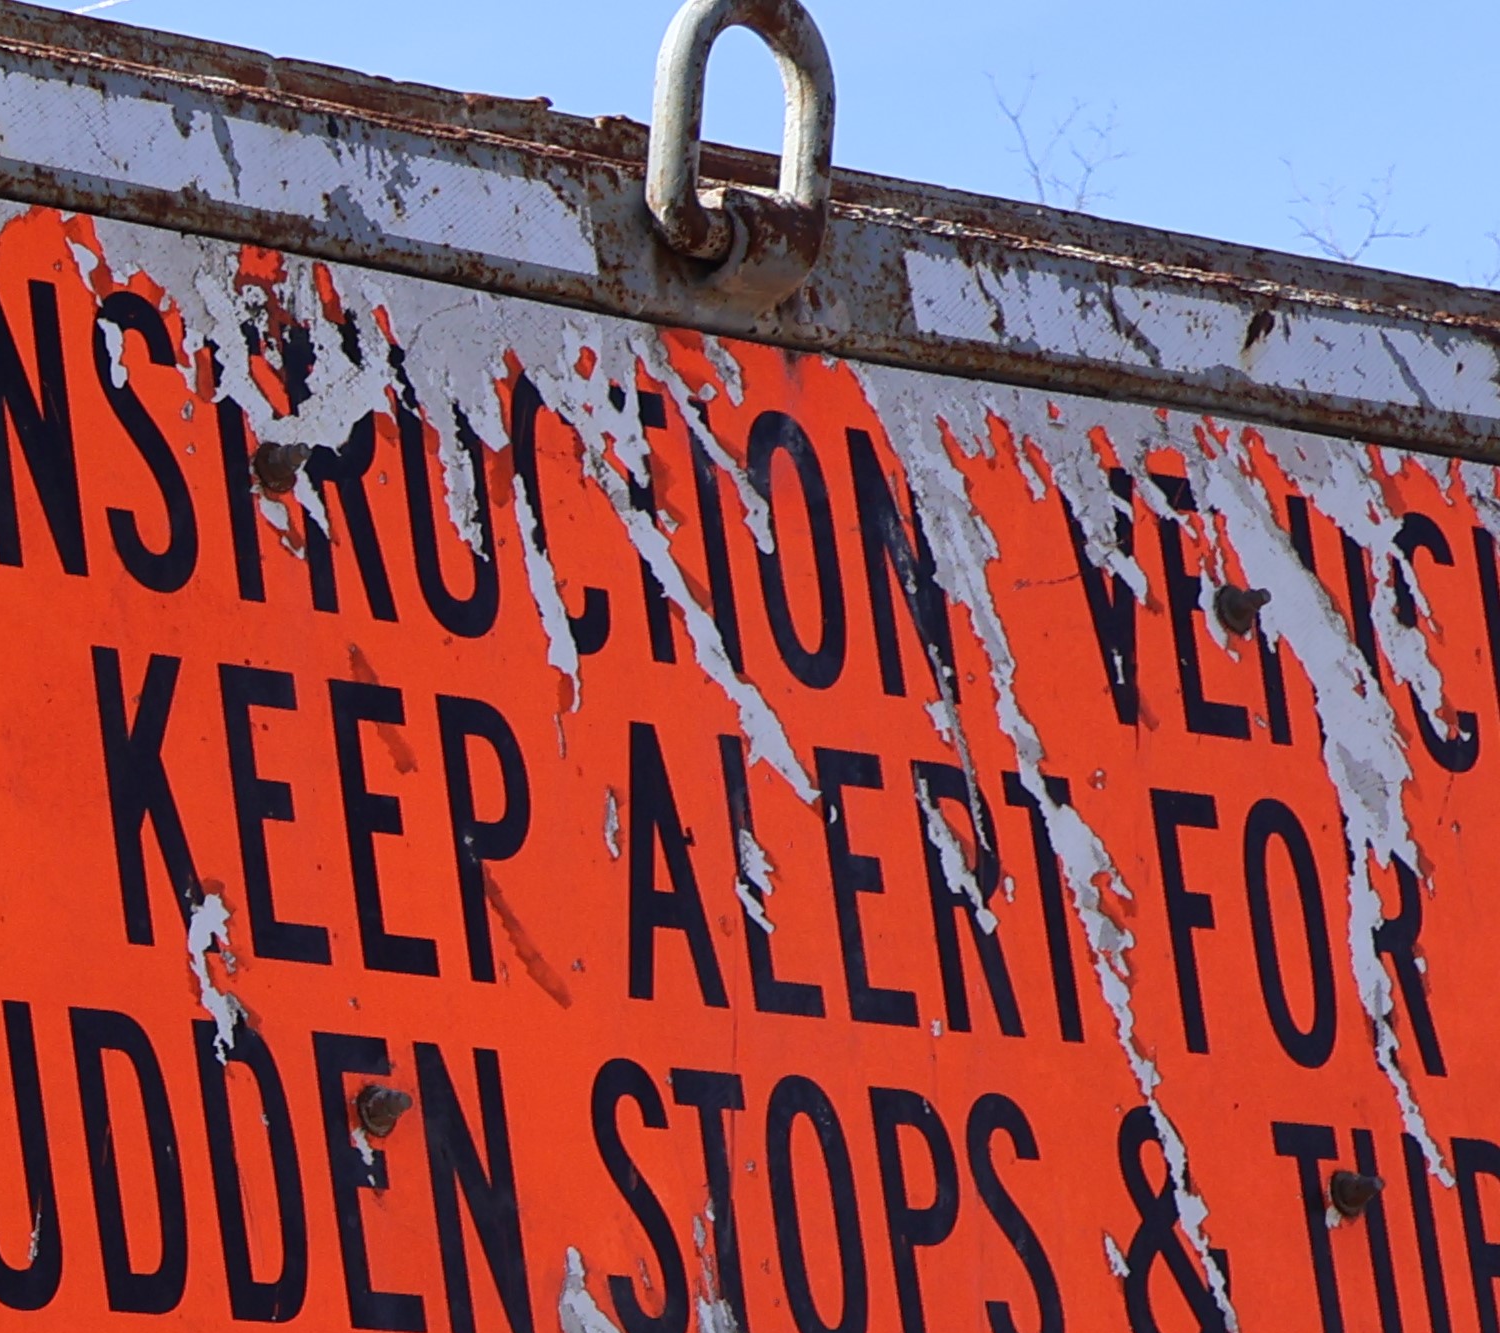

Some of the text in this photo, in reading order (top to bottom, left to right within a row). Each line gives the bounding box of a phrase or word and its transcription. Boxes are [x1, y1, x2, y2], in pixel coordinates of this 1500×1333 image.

[90, 645, 1448, 1077] KEEP ALERT FOR
